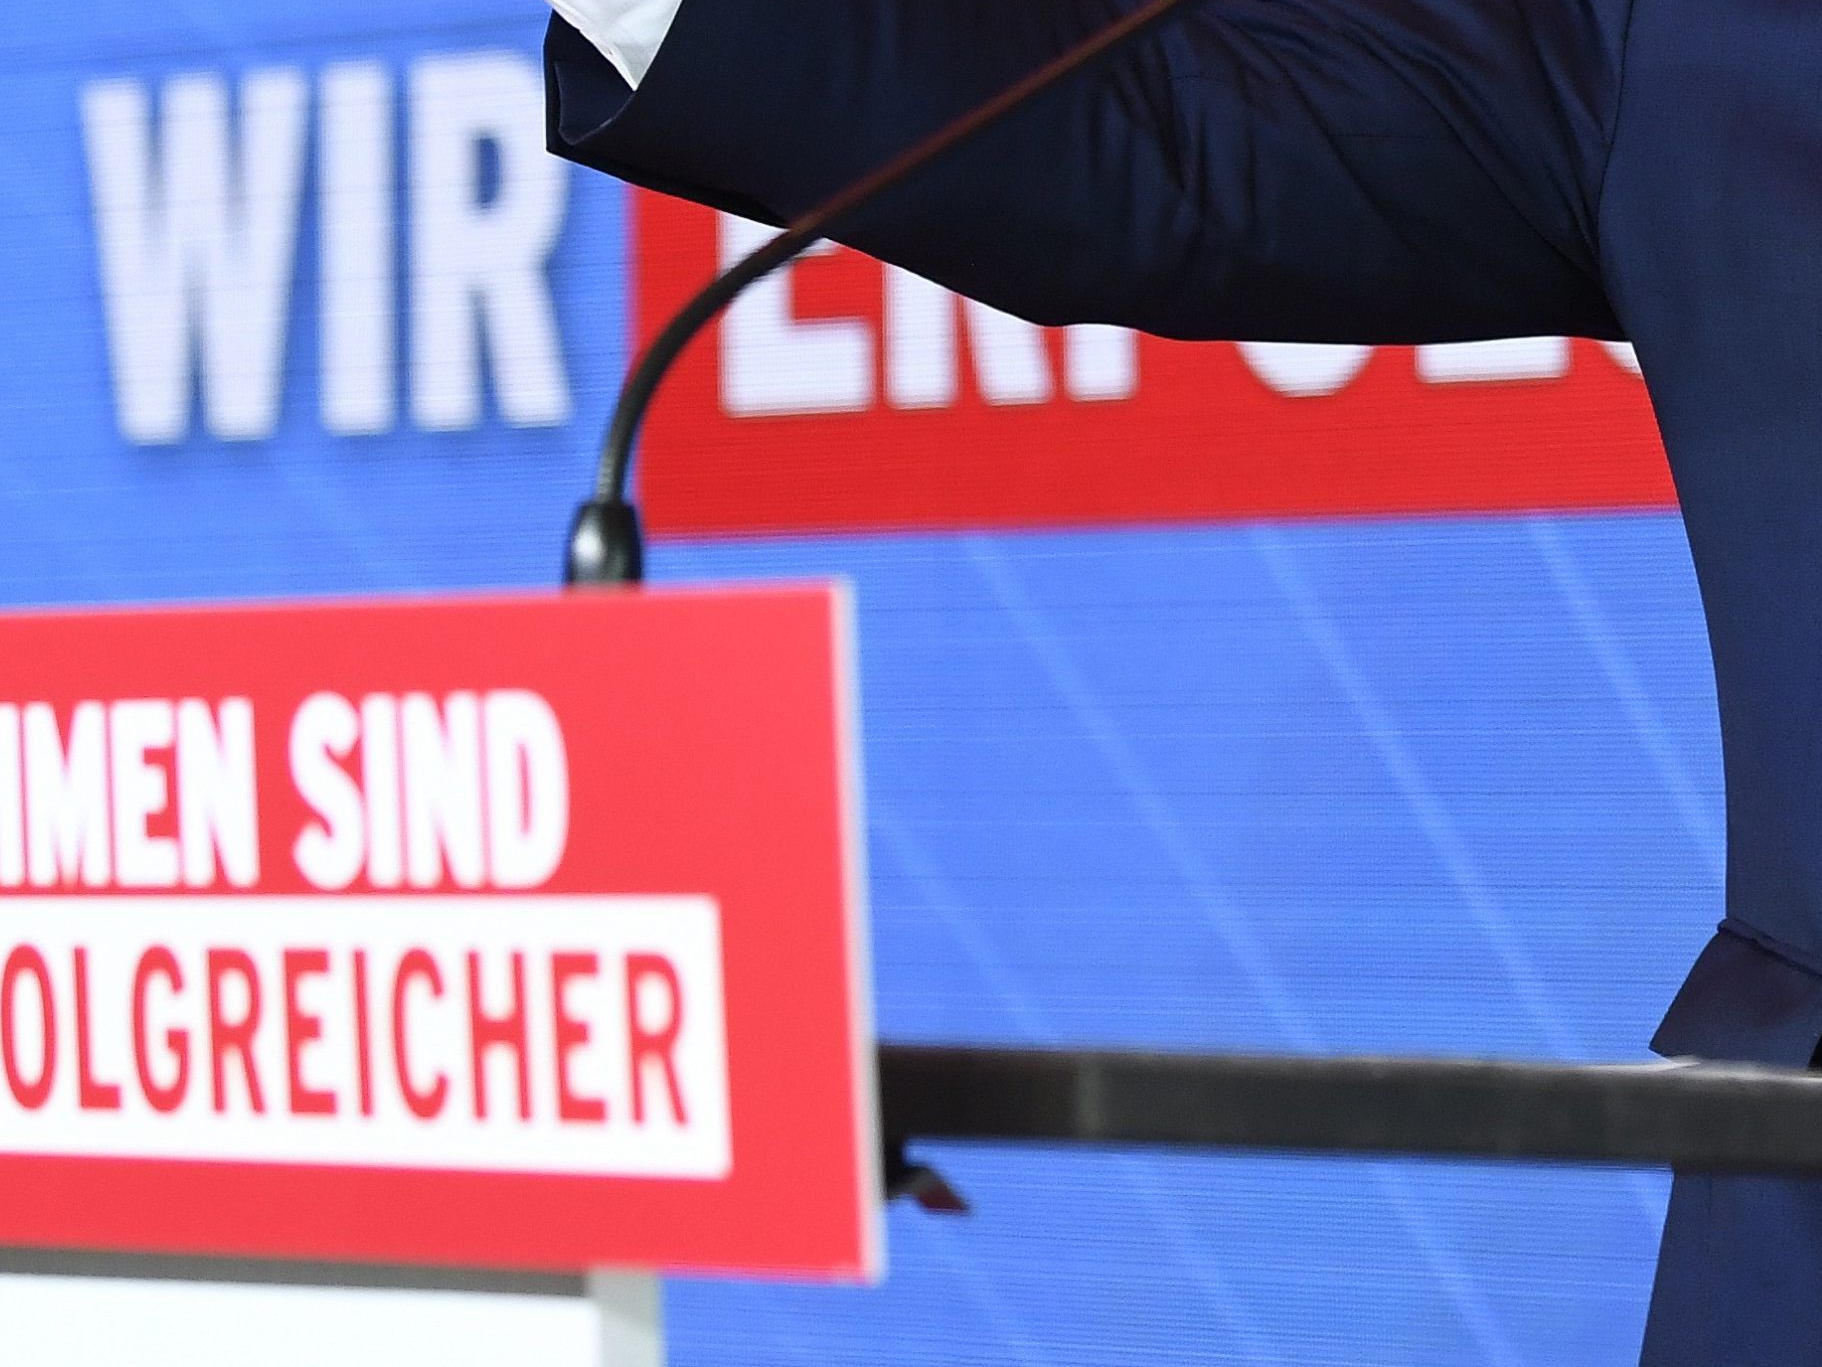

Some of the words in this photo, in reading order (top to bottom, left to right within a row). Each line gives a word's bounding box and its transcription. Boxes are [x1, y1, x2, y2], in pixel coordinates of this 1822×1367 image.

[80, 47, 573, 447] WIR
[0, 696, 260, 891] MEN
[288, 689, 570, 890] SIND
[0, 943, 690, 1127] OLGREICHER
